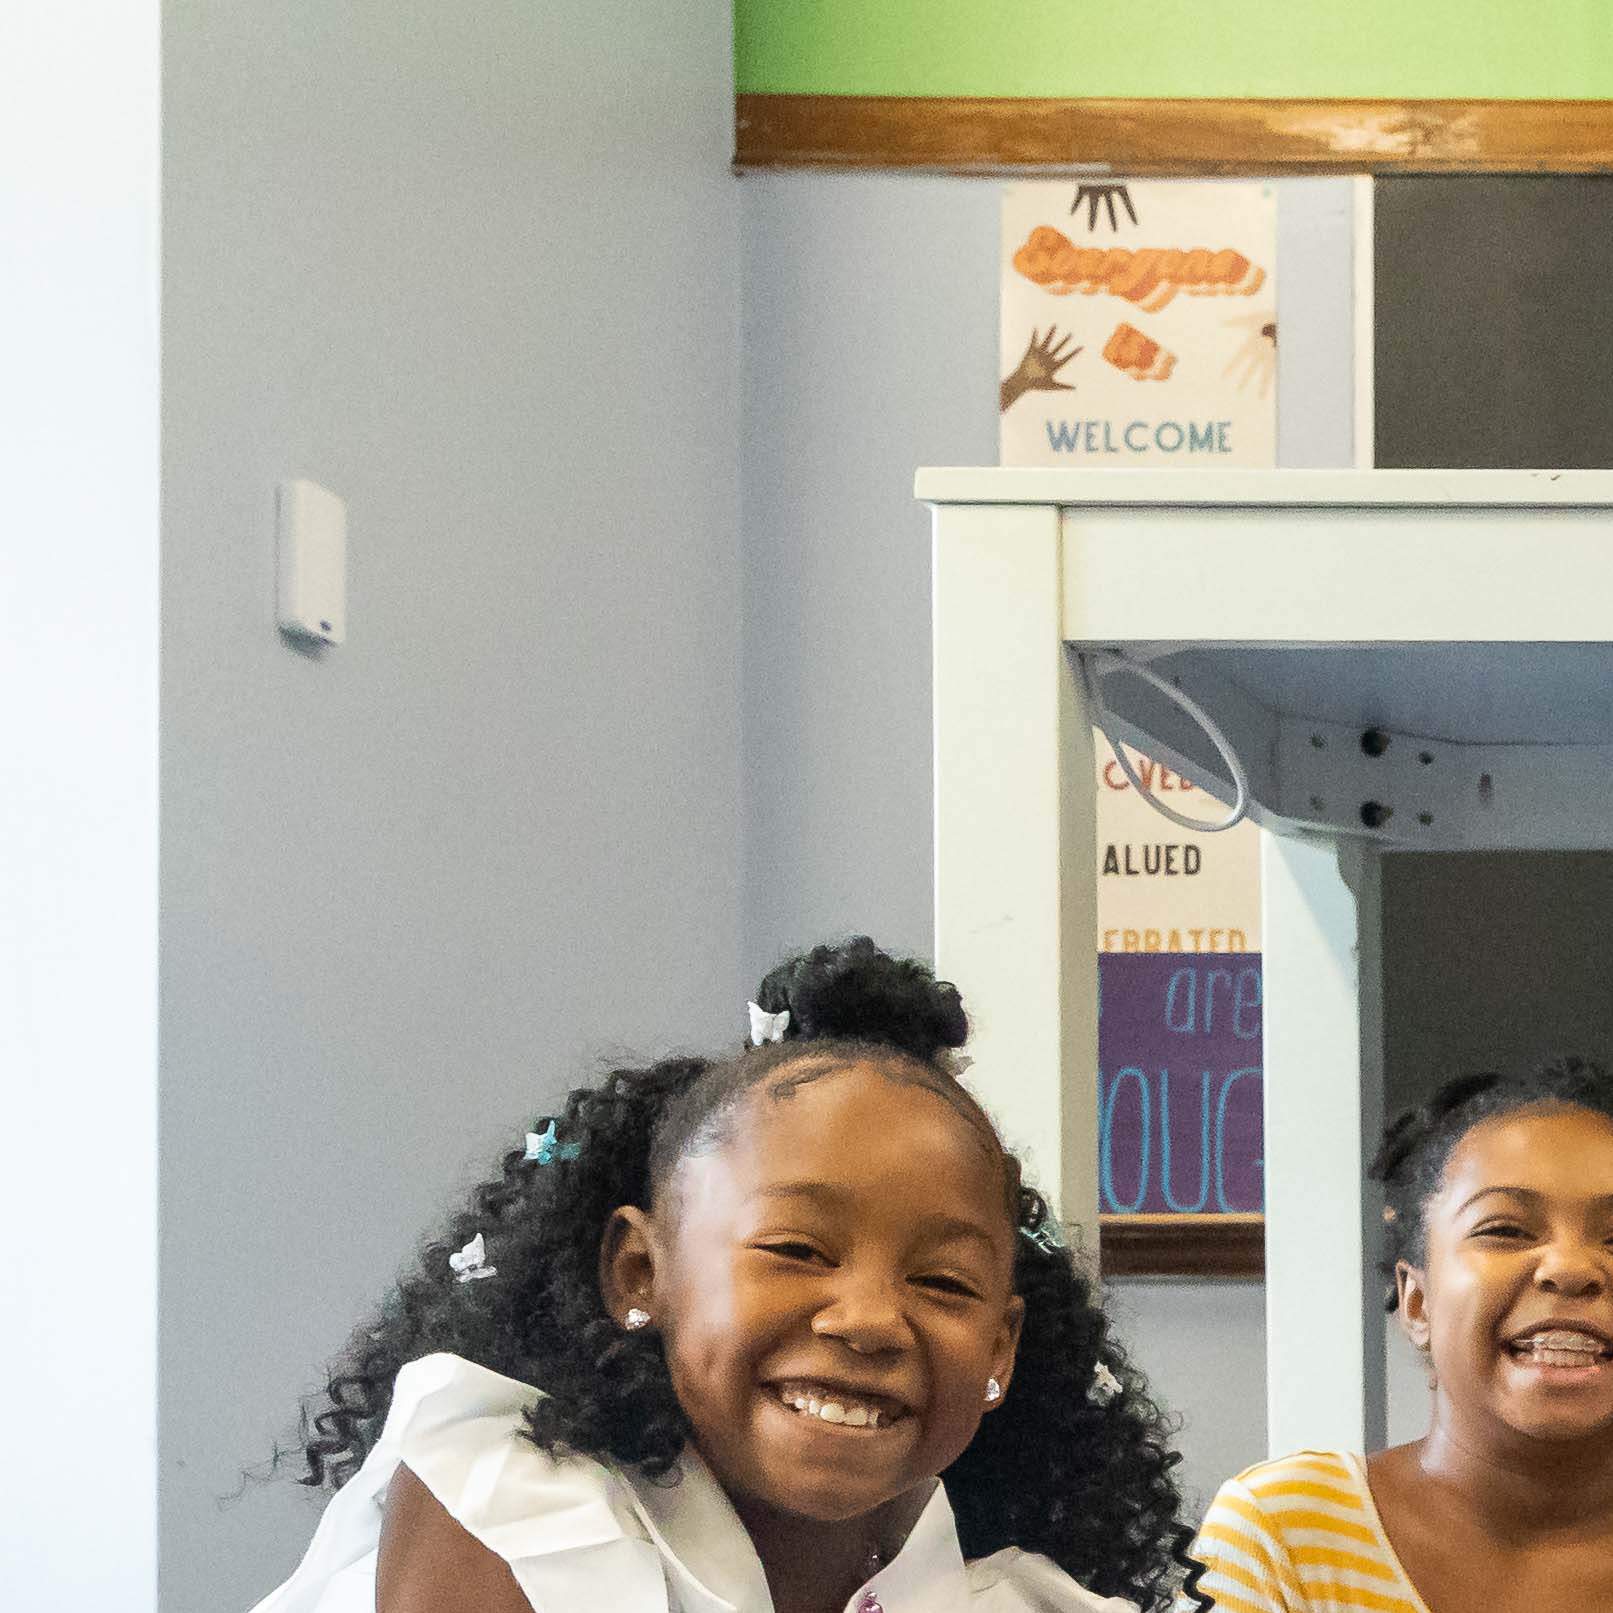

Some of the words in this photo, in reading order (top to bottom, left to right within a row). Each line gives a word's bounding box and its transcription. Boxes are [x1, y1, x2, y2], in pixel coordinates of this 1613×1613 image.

[1046, 421, 1232, 453] WELCOME
[1103, 844, 1202, 875] ALUED
[1103, 928, 1248, 953] EBRATED
[1165, 967, 1263, 1040] are
